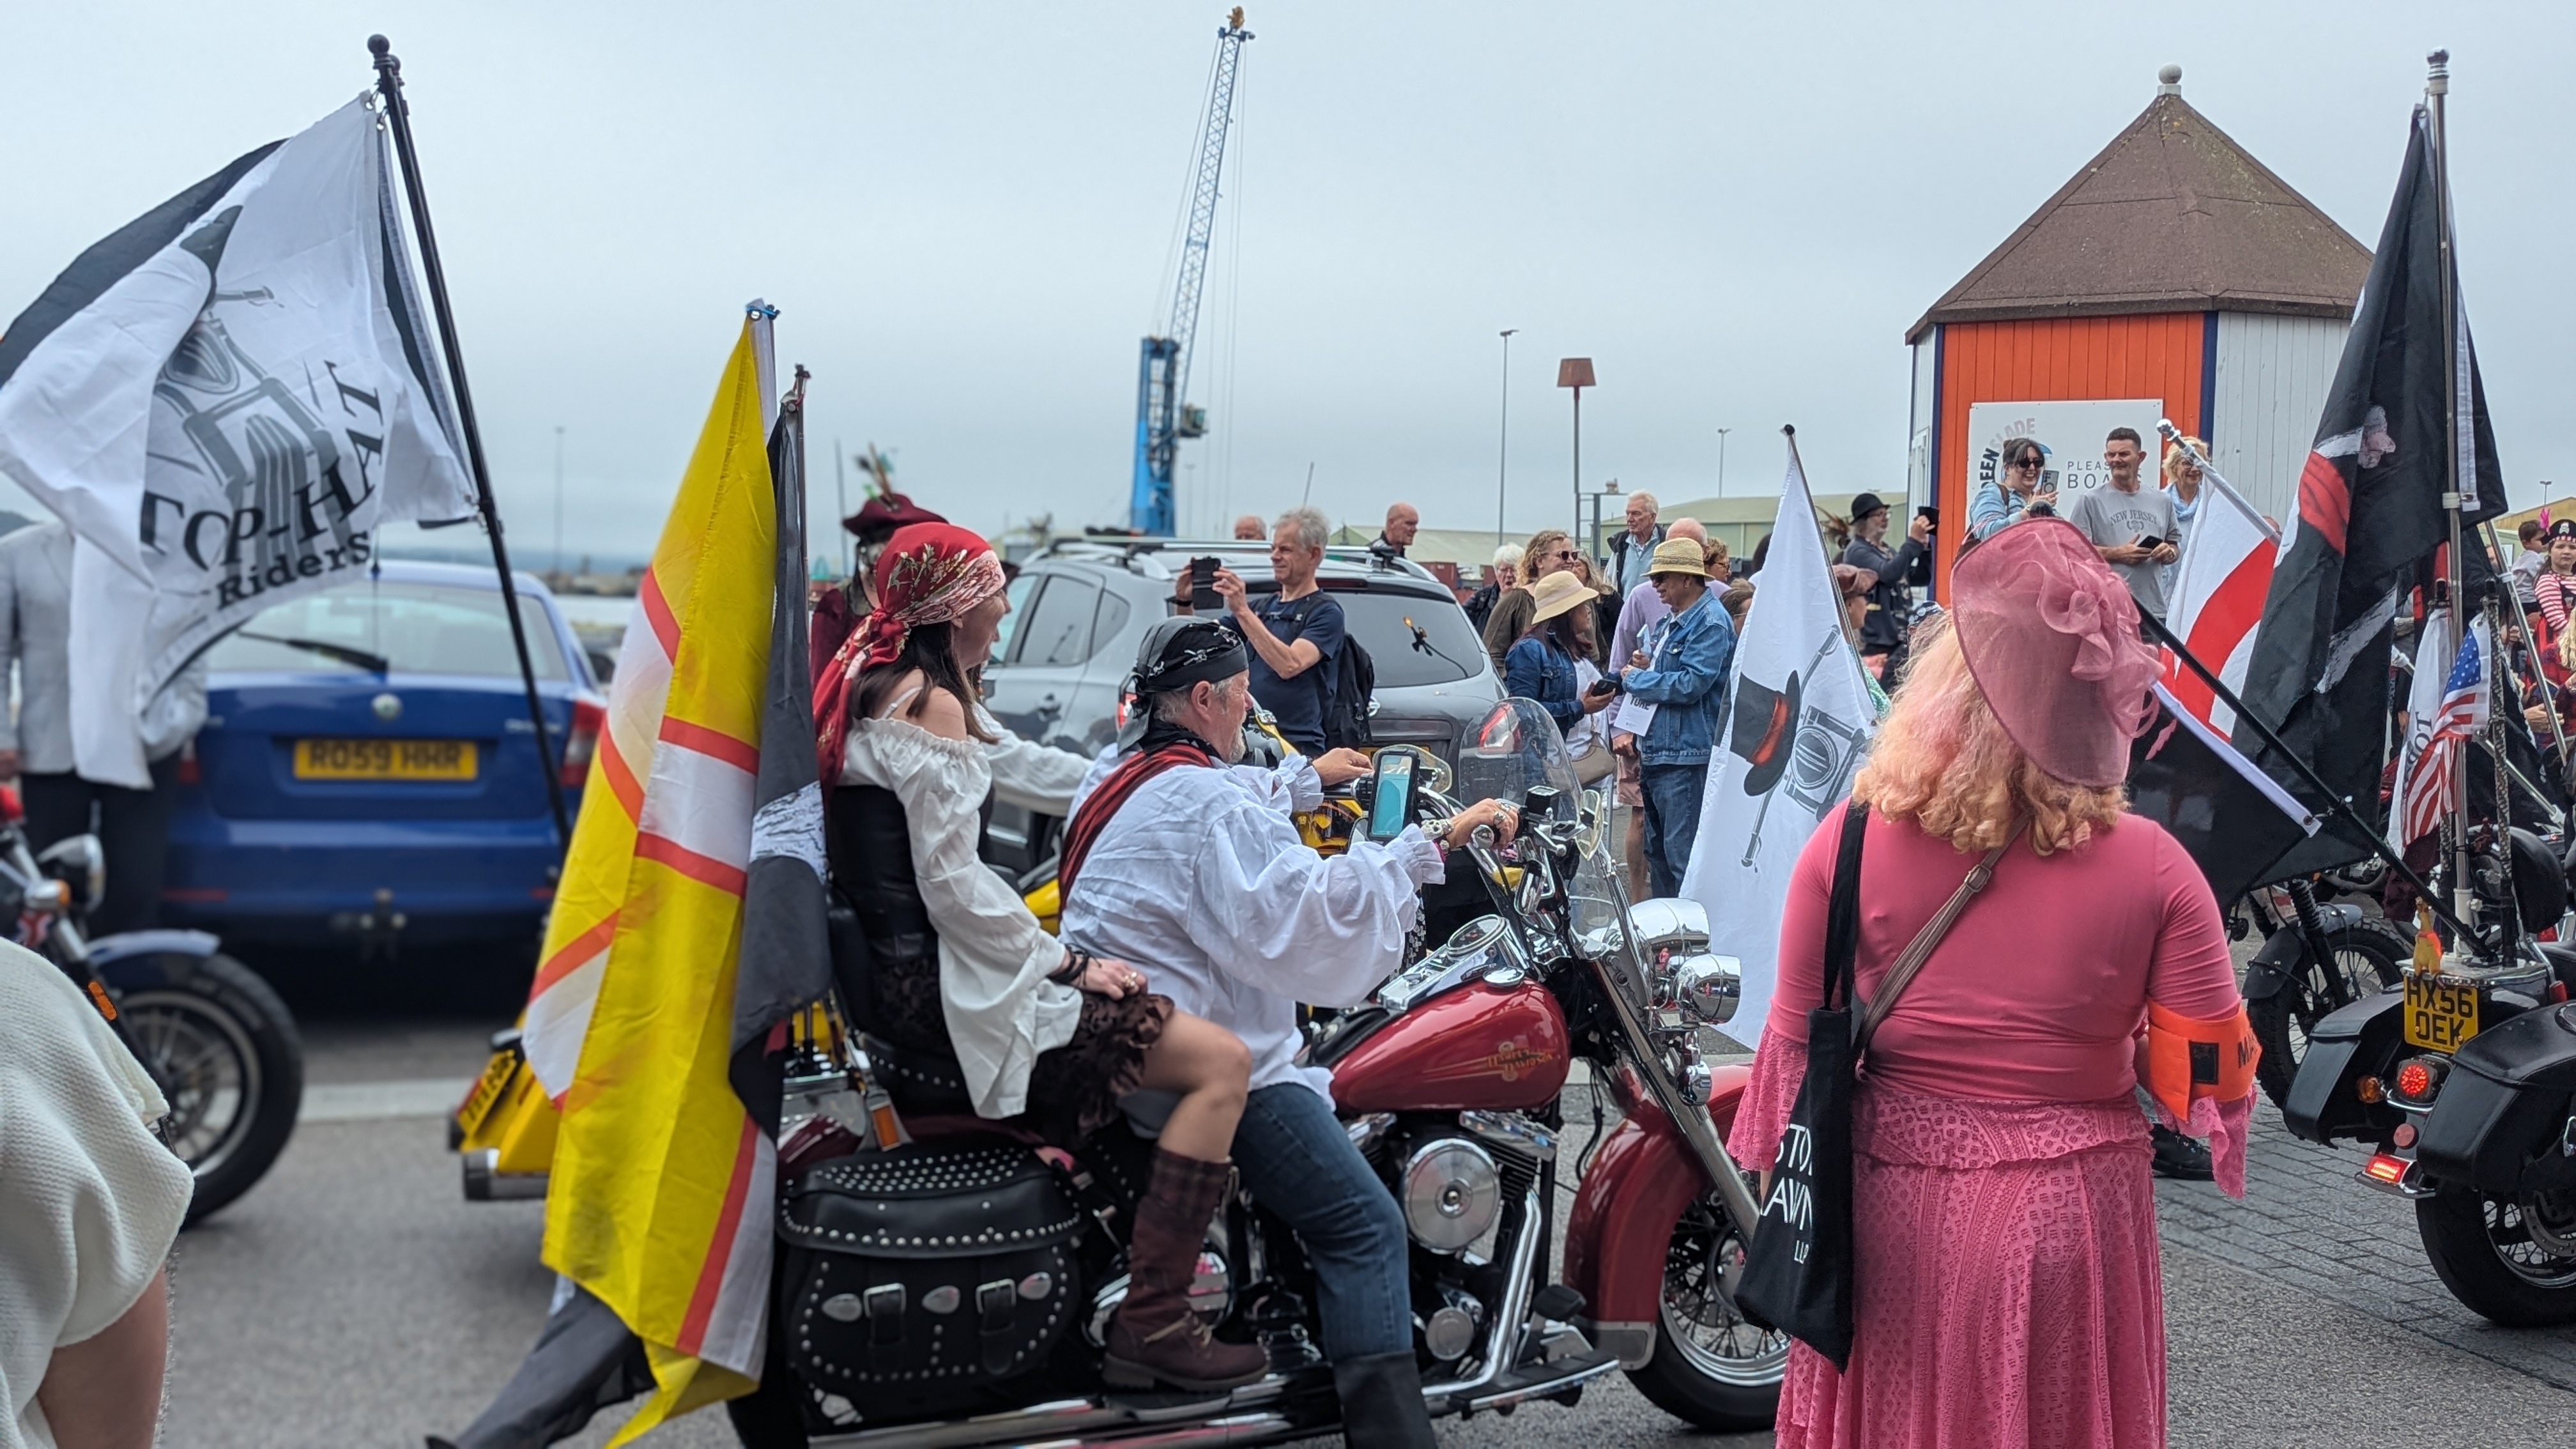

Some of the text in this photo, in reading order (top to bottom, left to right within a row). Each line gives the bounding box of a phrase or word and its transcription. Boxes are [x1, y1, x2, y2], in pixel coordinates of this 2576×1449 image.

[2110, 509, 2158, 526] NEW JERSEY
[217, 530, 371, 611] Riders
[2406, 976, 2473, 1018] HX56
[2416, 1010, 2465, 1047] OEK
